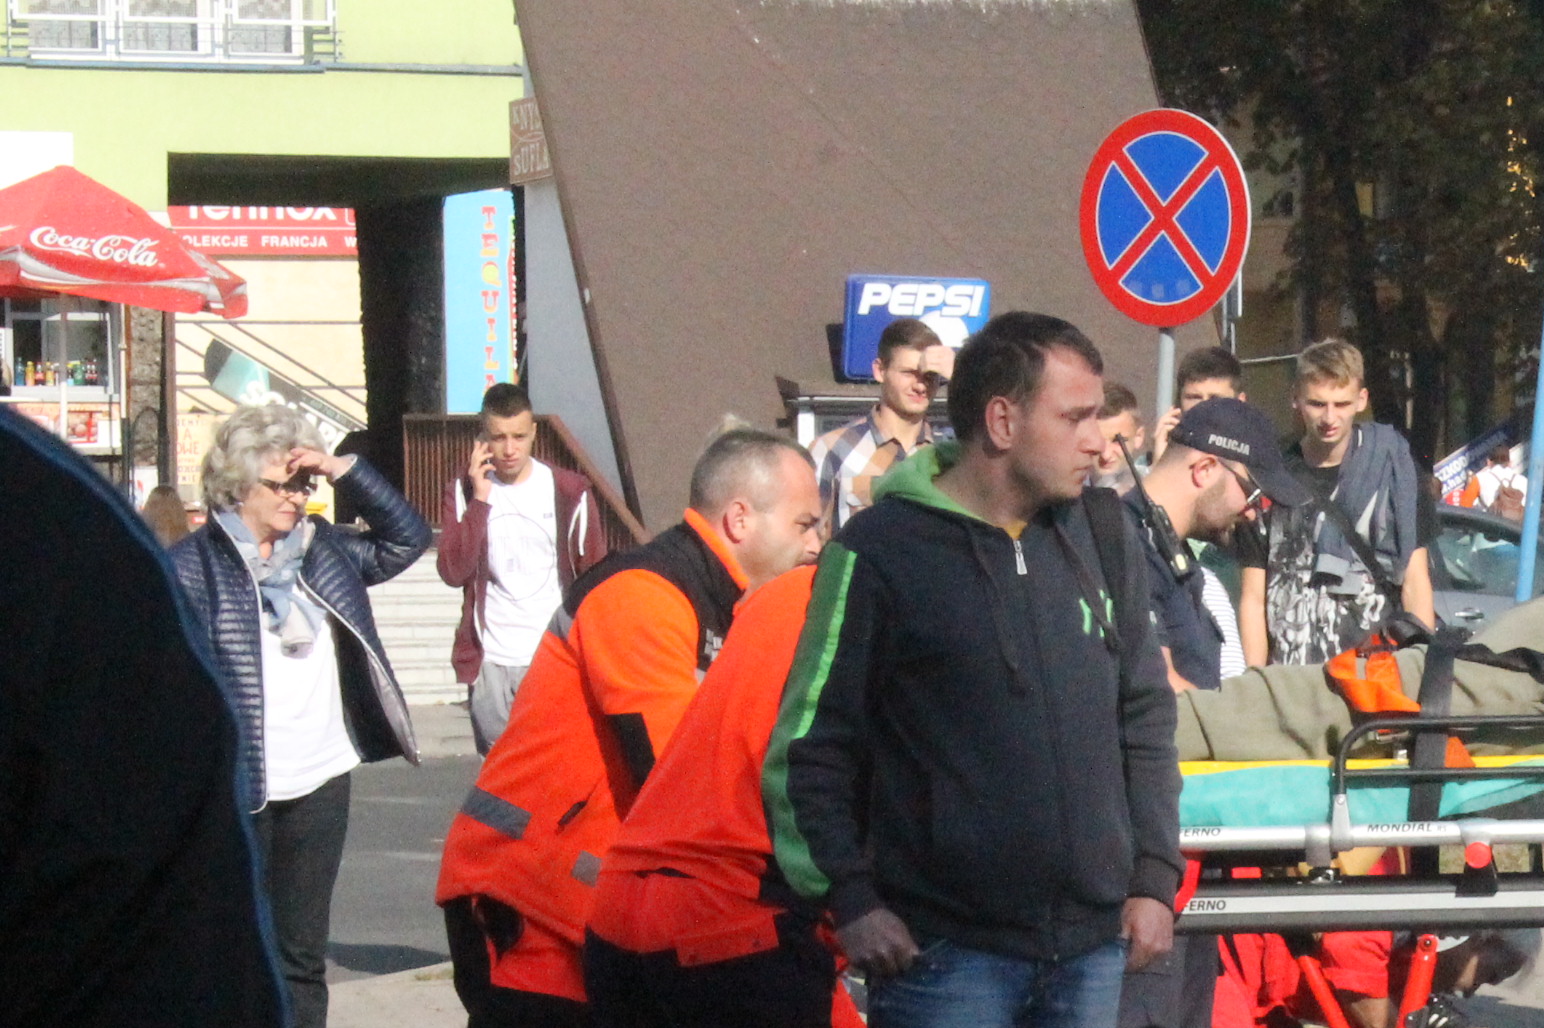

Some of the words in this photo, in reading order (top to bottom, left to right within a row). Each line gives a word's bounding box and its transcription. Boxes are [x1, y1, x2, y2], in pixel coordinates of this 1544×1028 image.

[29, 226, 160, 267] Coca-Cola
[260, 235, 328, 248] FRANCJA
[857, 282, 986, 318] PEPSI
[1207, 433, 1251, 456] POLICJA
[1367, 822, 1432, 833] MONDIAL
[1186, 899, 1227, 912] ERNO
